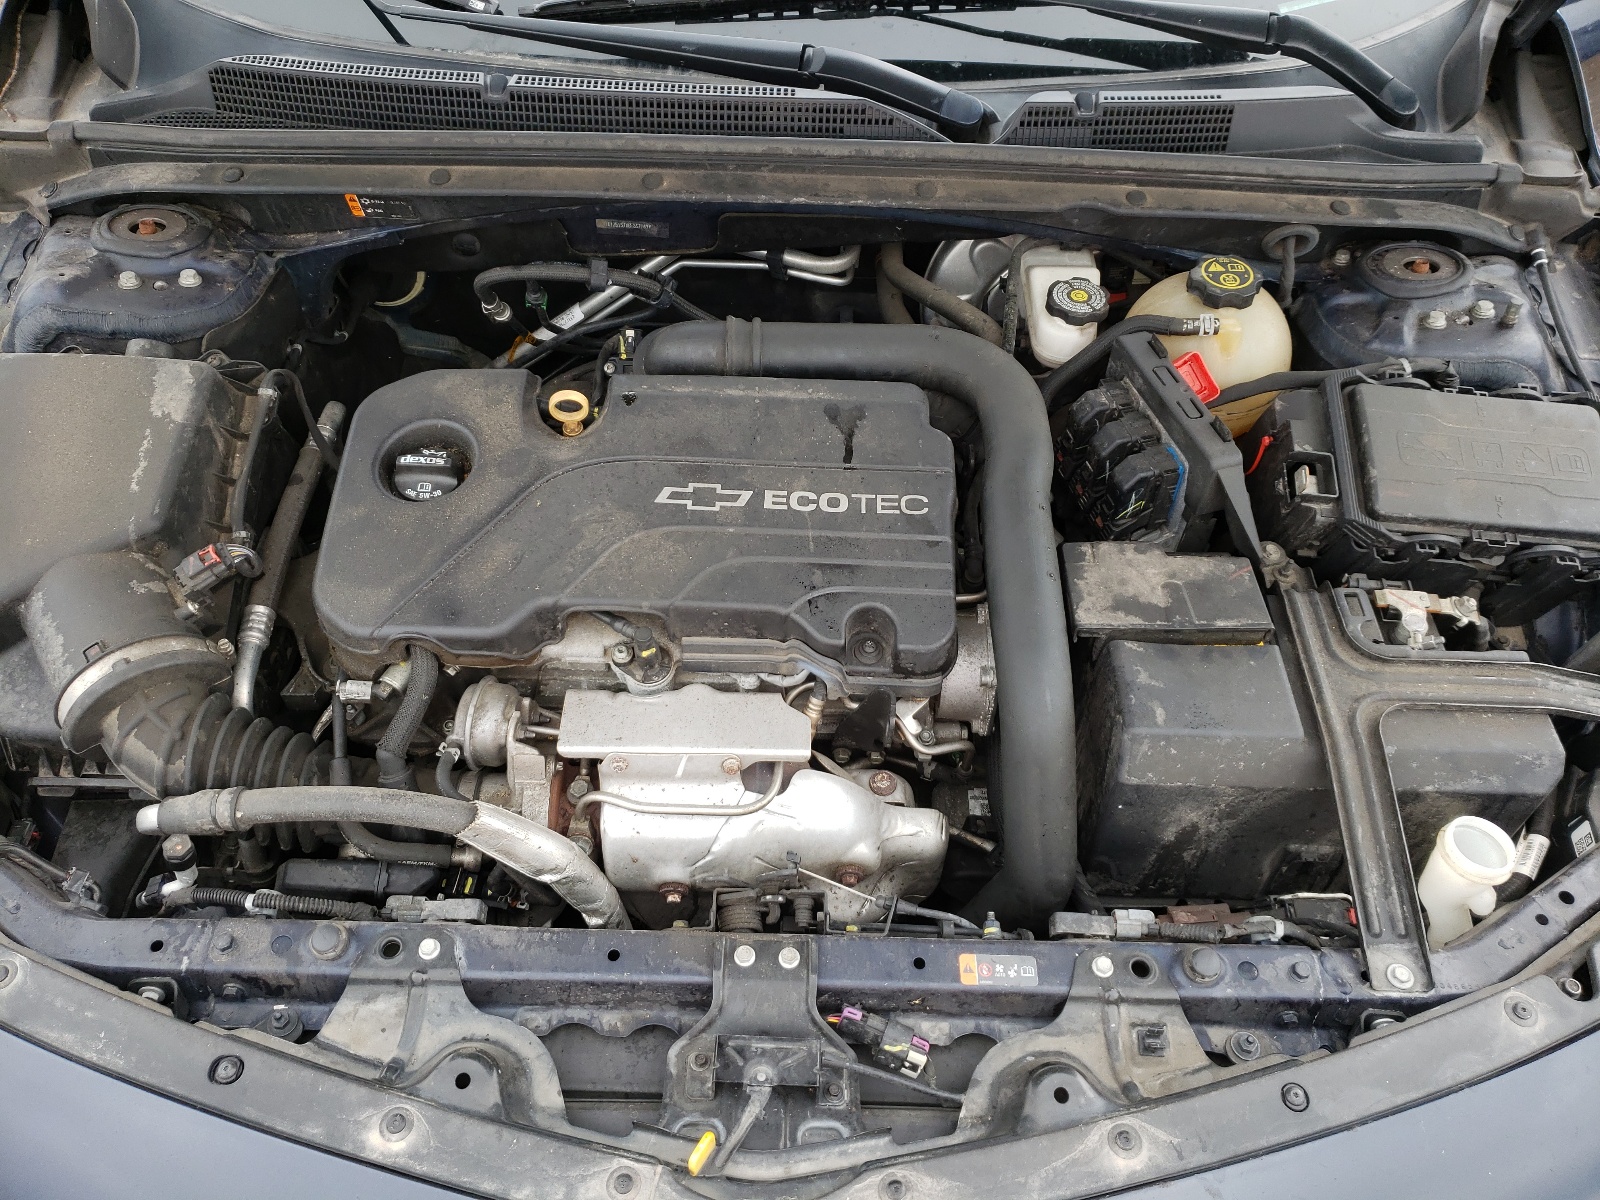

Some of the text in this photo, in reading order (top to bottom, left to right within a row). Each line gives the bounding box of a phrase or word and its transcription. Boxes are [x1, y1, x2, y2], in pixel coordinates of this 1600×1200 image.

[400, 454, 447, 465] dexos
[405, 488, 442, 499] SAE 5W-30
[763, 489, 929, 515] ECOTEC
